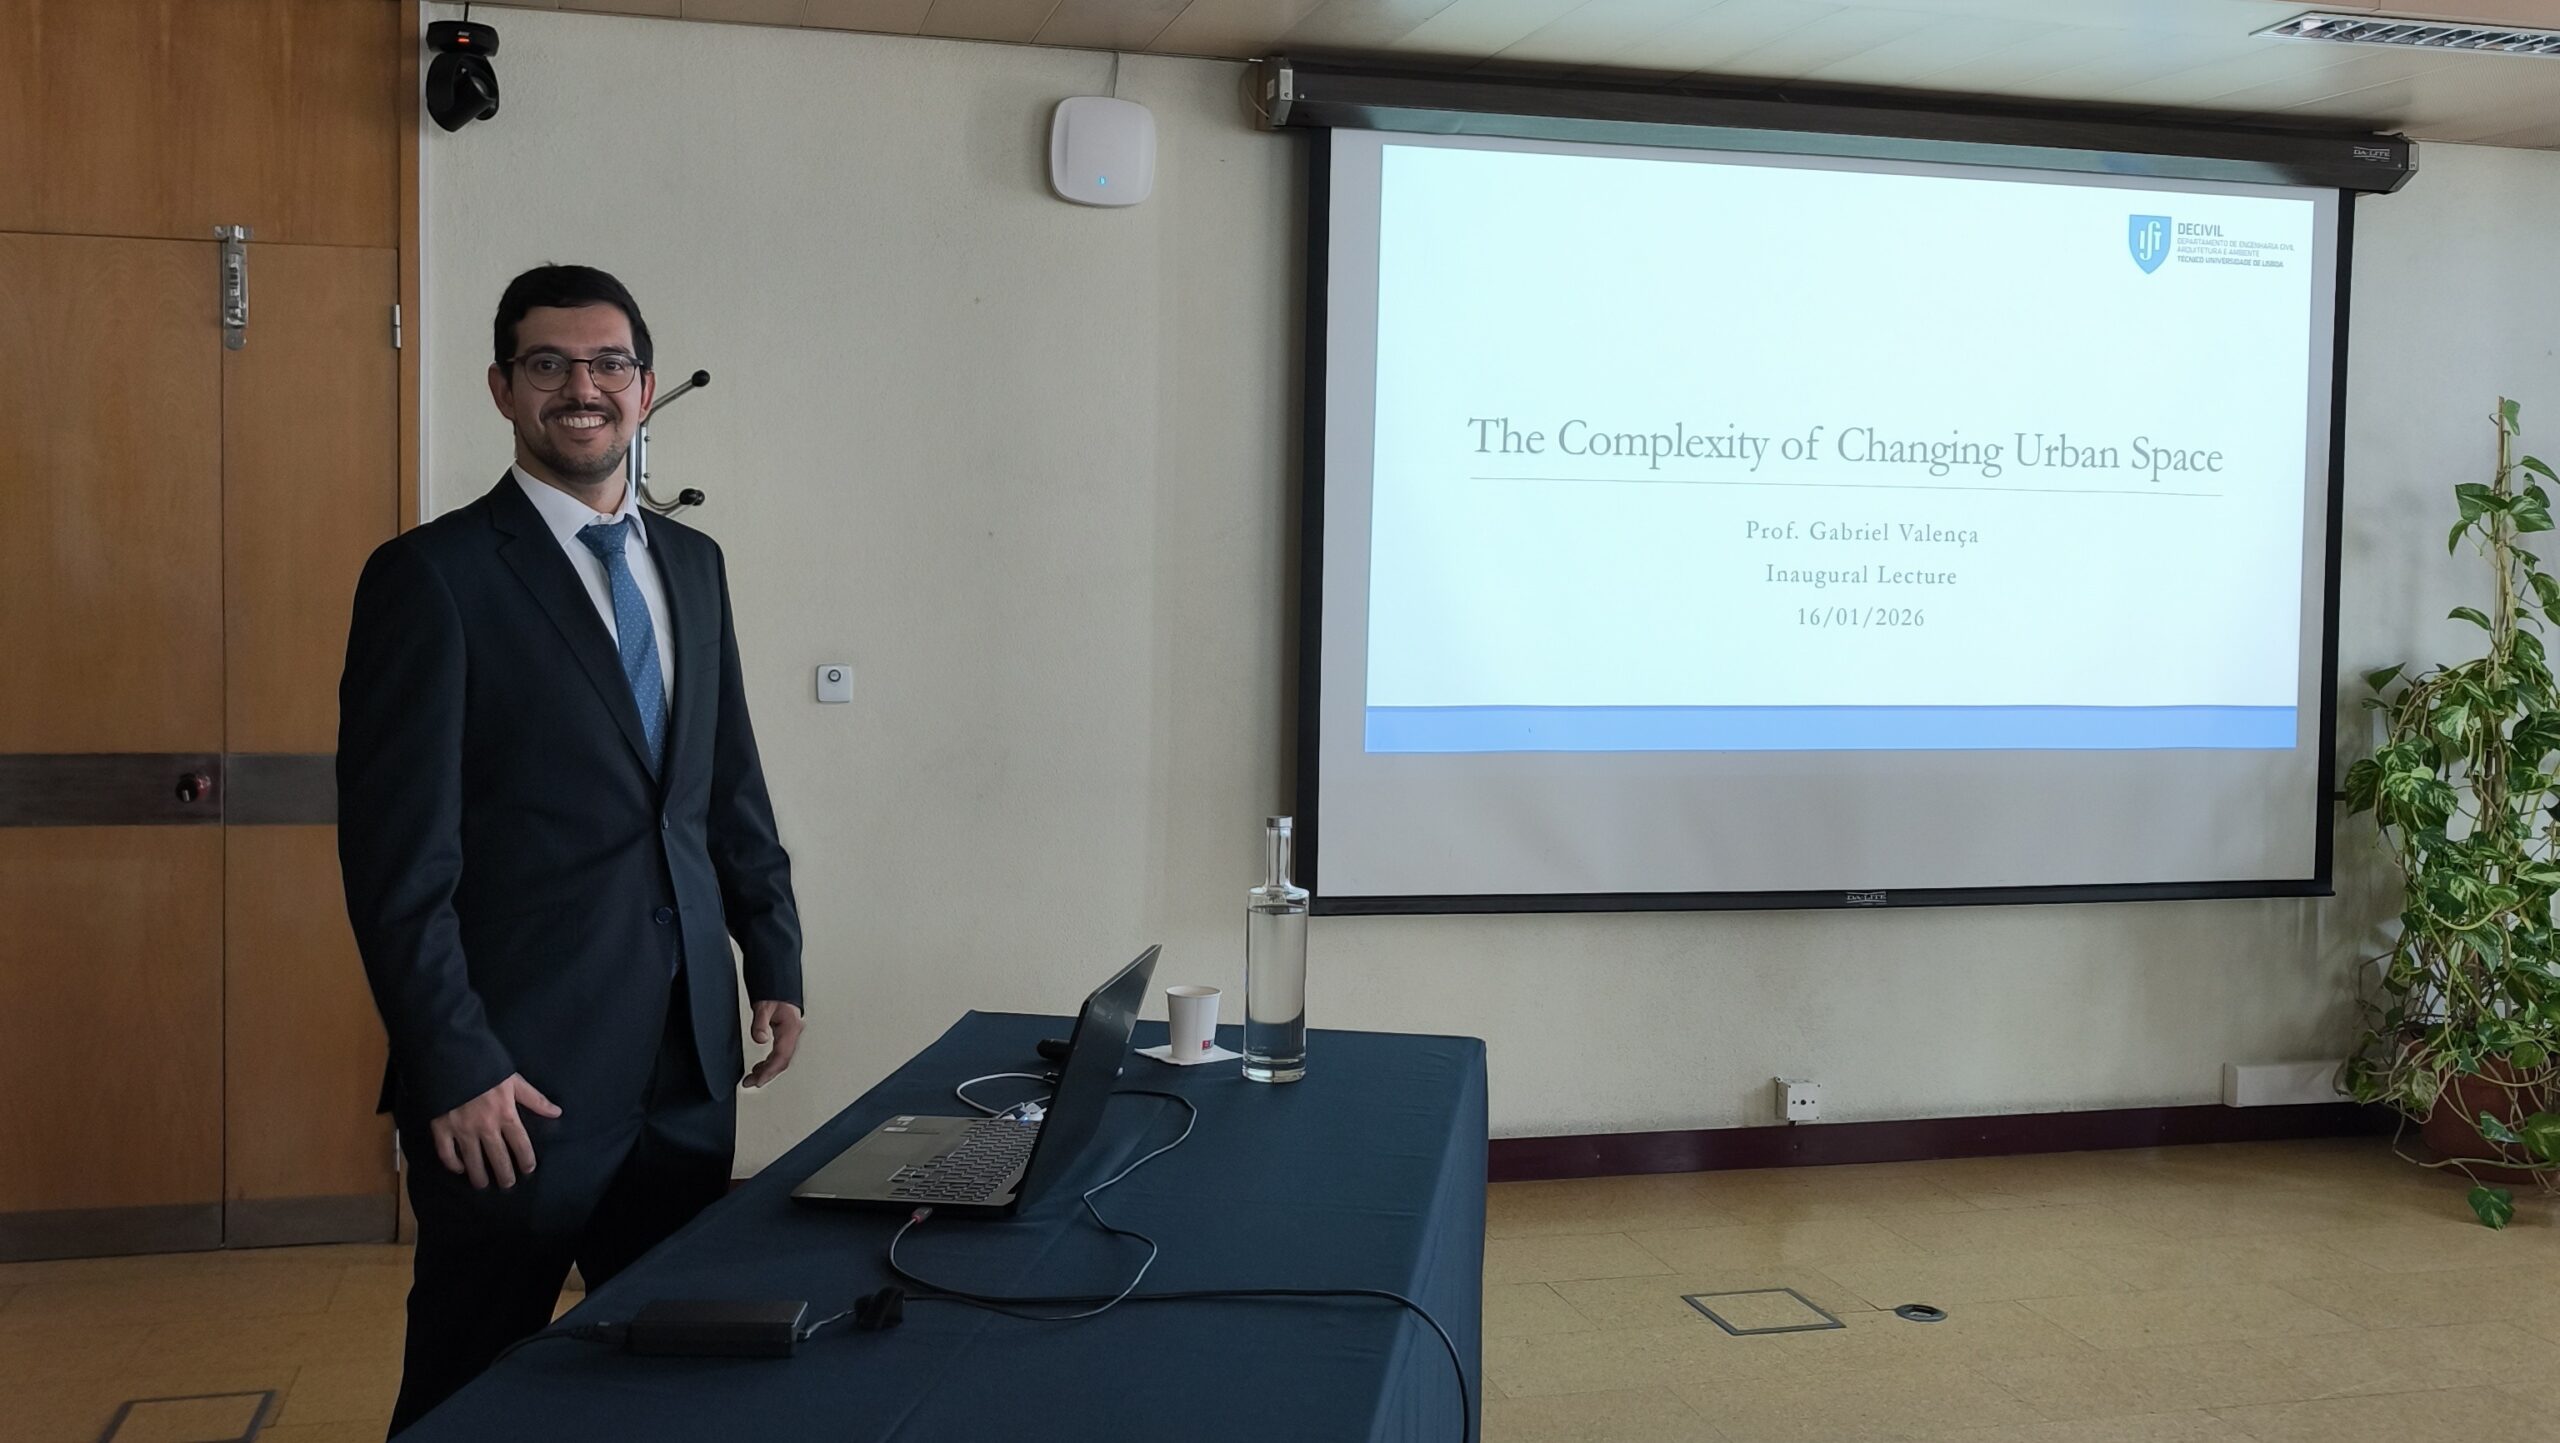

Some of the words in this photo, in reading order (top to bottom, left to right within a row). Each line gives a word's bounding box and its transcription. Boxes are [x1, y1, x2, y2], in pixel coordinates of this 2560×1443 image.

[2177, 222, 2224, 237] DECIVIL
[2177, 238, 2228, 247] DEPARTAMENTO
[2229, 240, 2237, 248] DE
[1467, 417, 1545, 455] The
[1558, 420, 1770, 472] Complexity
[1780, 425, 1825, 461] of
[1837, 427, 2005, 478] Changing
[2014, 432, 2121, 470] Urban
[2131, 436, 2224, 483] Space
[1746, 520, 1799, 540] Prof.
[1809, 521, 1889, 542] Gabriel
[1898, 523, 1979, 548] Valença
[1766, 564, 1868, 589] Inaugural
[1877, 566, 1957, 585] Lecture
[1797, 606, 1925, 629] 16/01/2026
